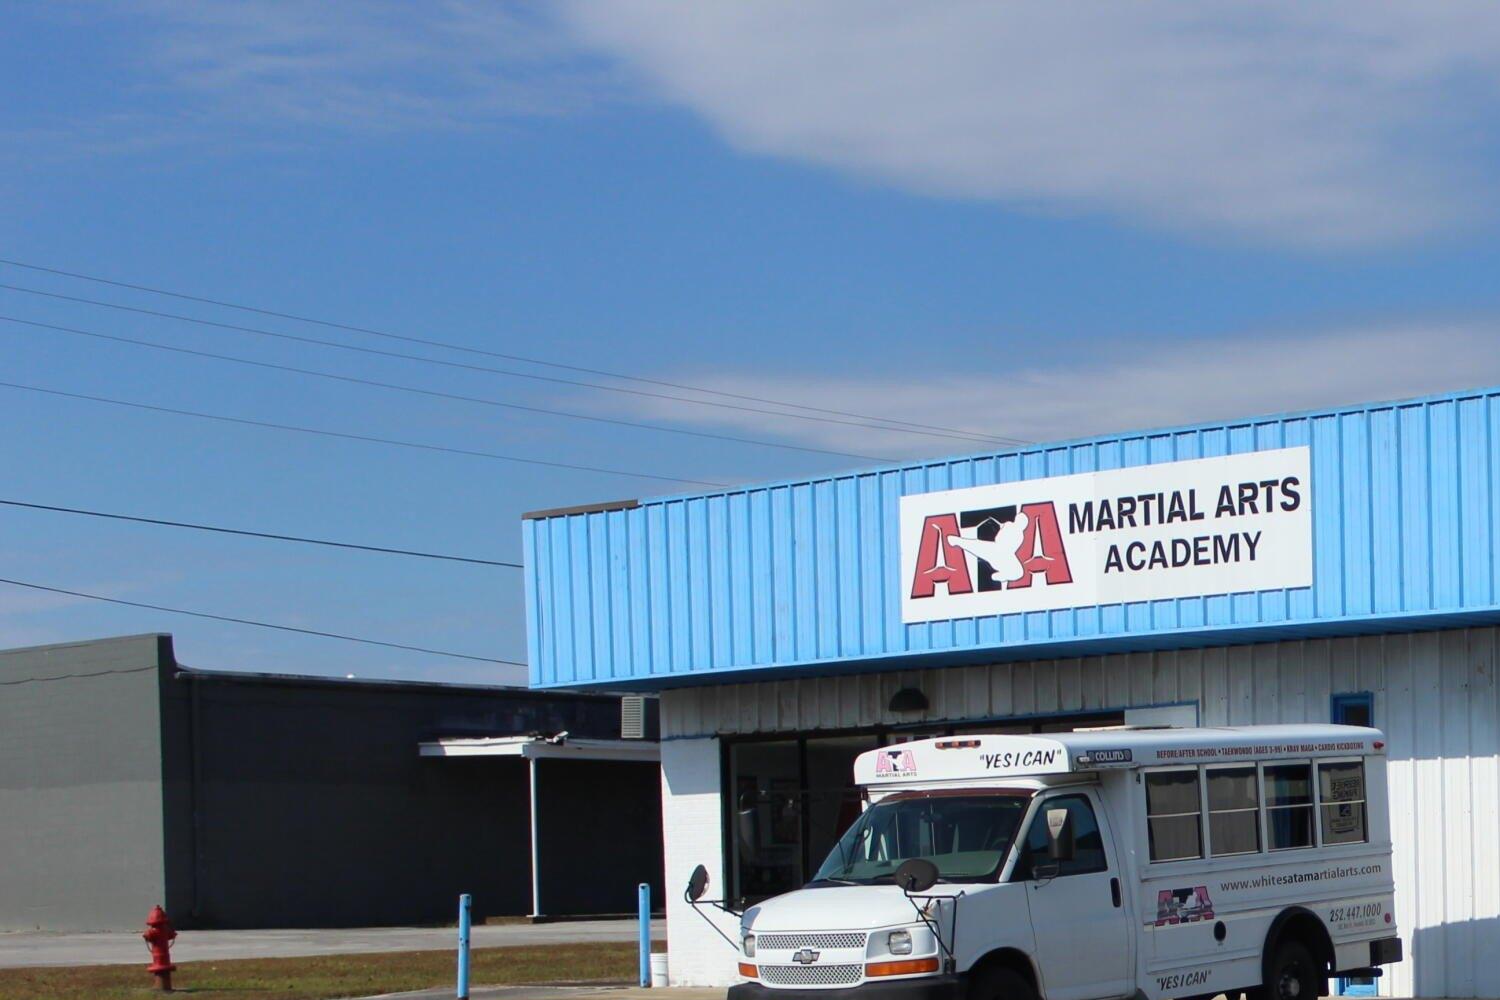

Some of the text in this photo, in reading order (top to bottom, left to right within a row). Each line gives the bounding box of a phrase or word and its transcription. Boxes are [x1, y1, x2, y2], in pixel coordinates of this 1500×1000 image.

[1068, 476, 1301, 534] MARTIAL ARTS
[910, 500, 1074, 599] ATA
[1104, 531, 1262, 574] ACADEMY
[1095, 750, 1125, 762] COLLINS
[1196, 748, 1218, 758] SCHOOL
[1221, 747, 1253, 756] TAEKWONDO
[1318, 742, 1336, 751] CARDIO
[1220, 863, 1382, 892] www.whitesatamartialarts.com
[1330, 902, 1382, 922] 252.447.1000
